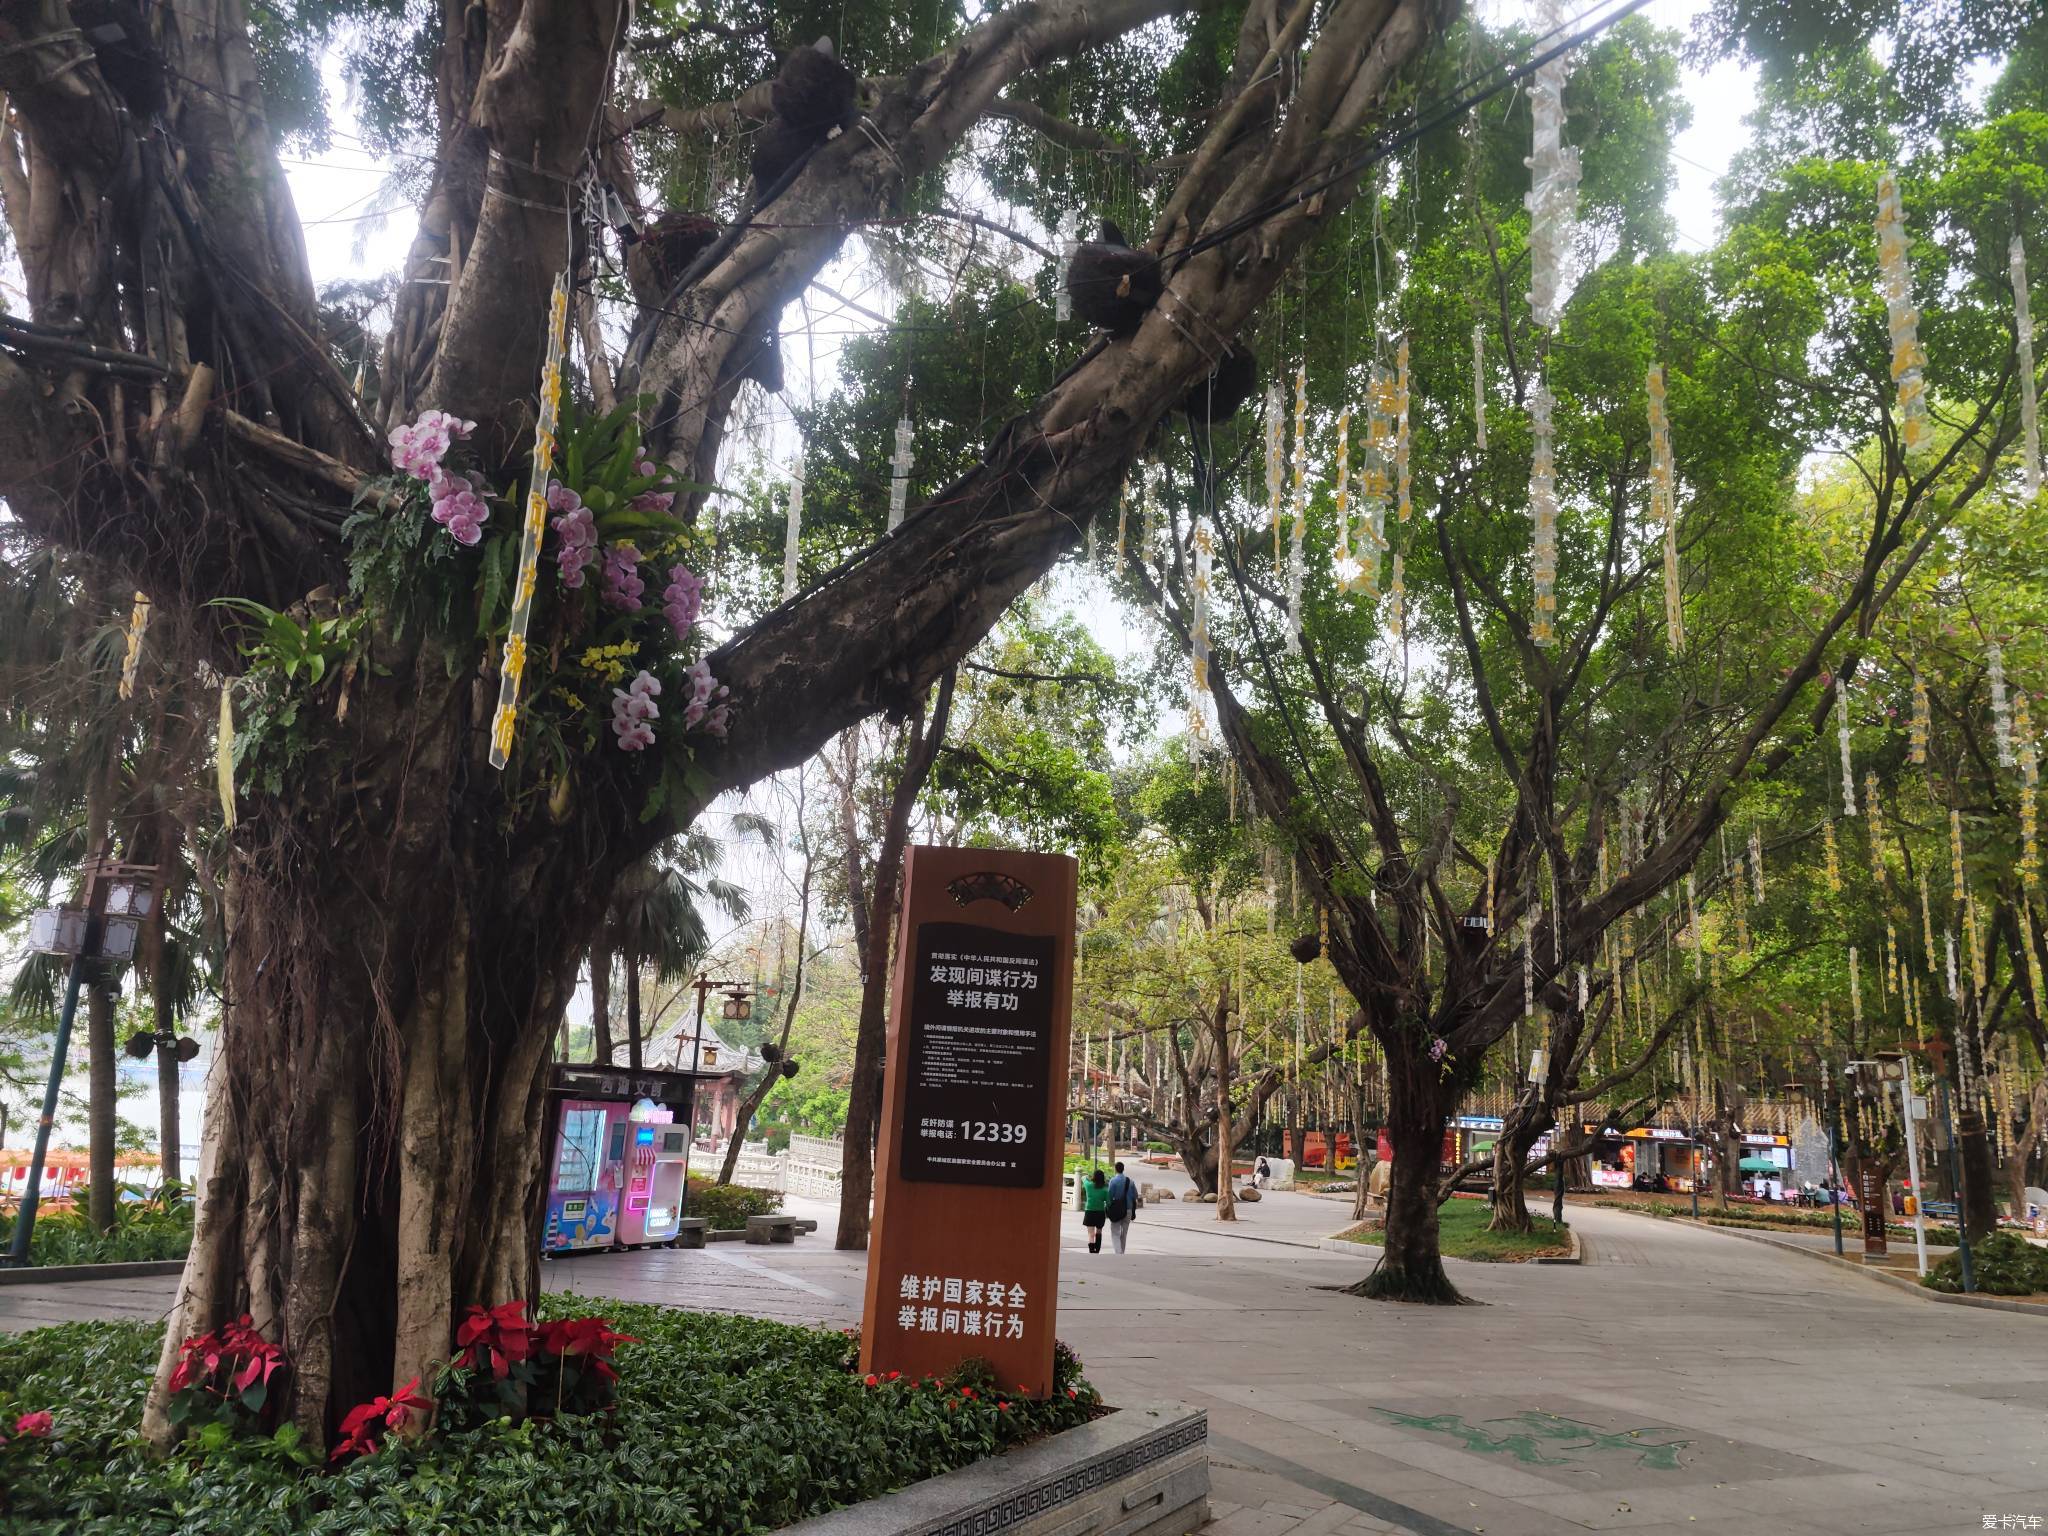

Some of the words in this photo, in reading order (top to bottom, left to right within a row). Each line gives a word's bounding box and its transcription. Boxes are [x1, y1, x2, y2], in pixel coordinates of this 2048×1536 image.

[930, 966, 1038, 989] 发现间谍行为
[947, 989, 1019, 1011] 举报有功
[920, 1118, 954, 1129] 反奸防谍
[961, 1120, 1027, 1144] 12339
[900, 1274, 1027, 1308] 维护国家安全
[898, 1305, 1024, 1339] 举报间谍行为
